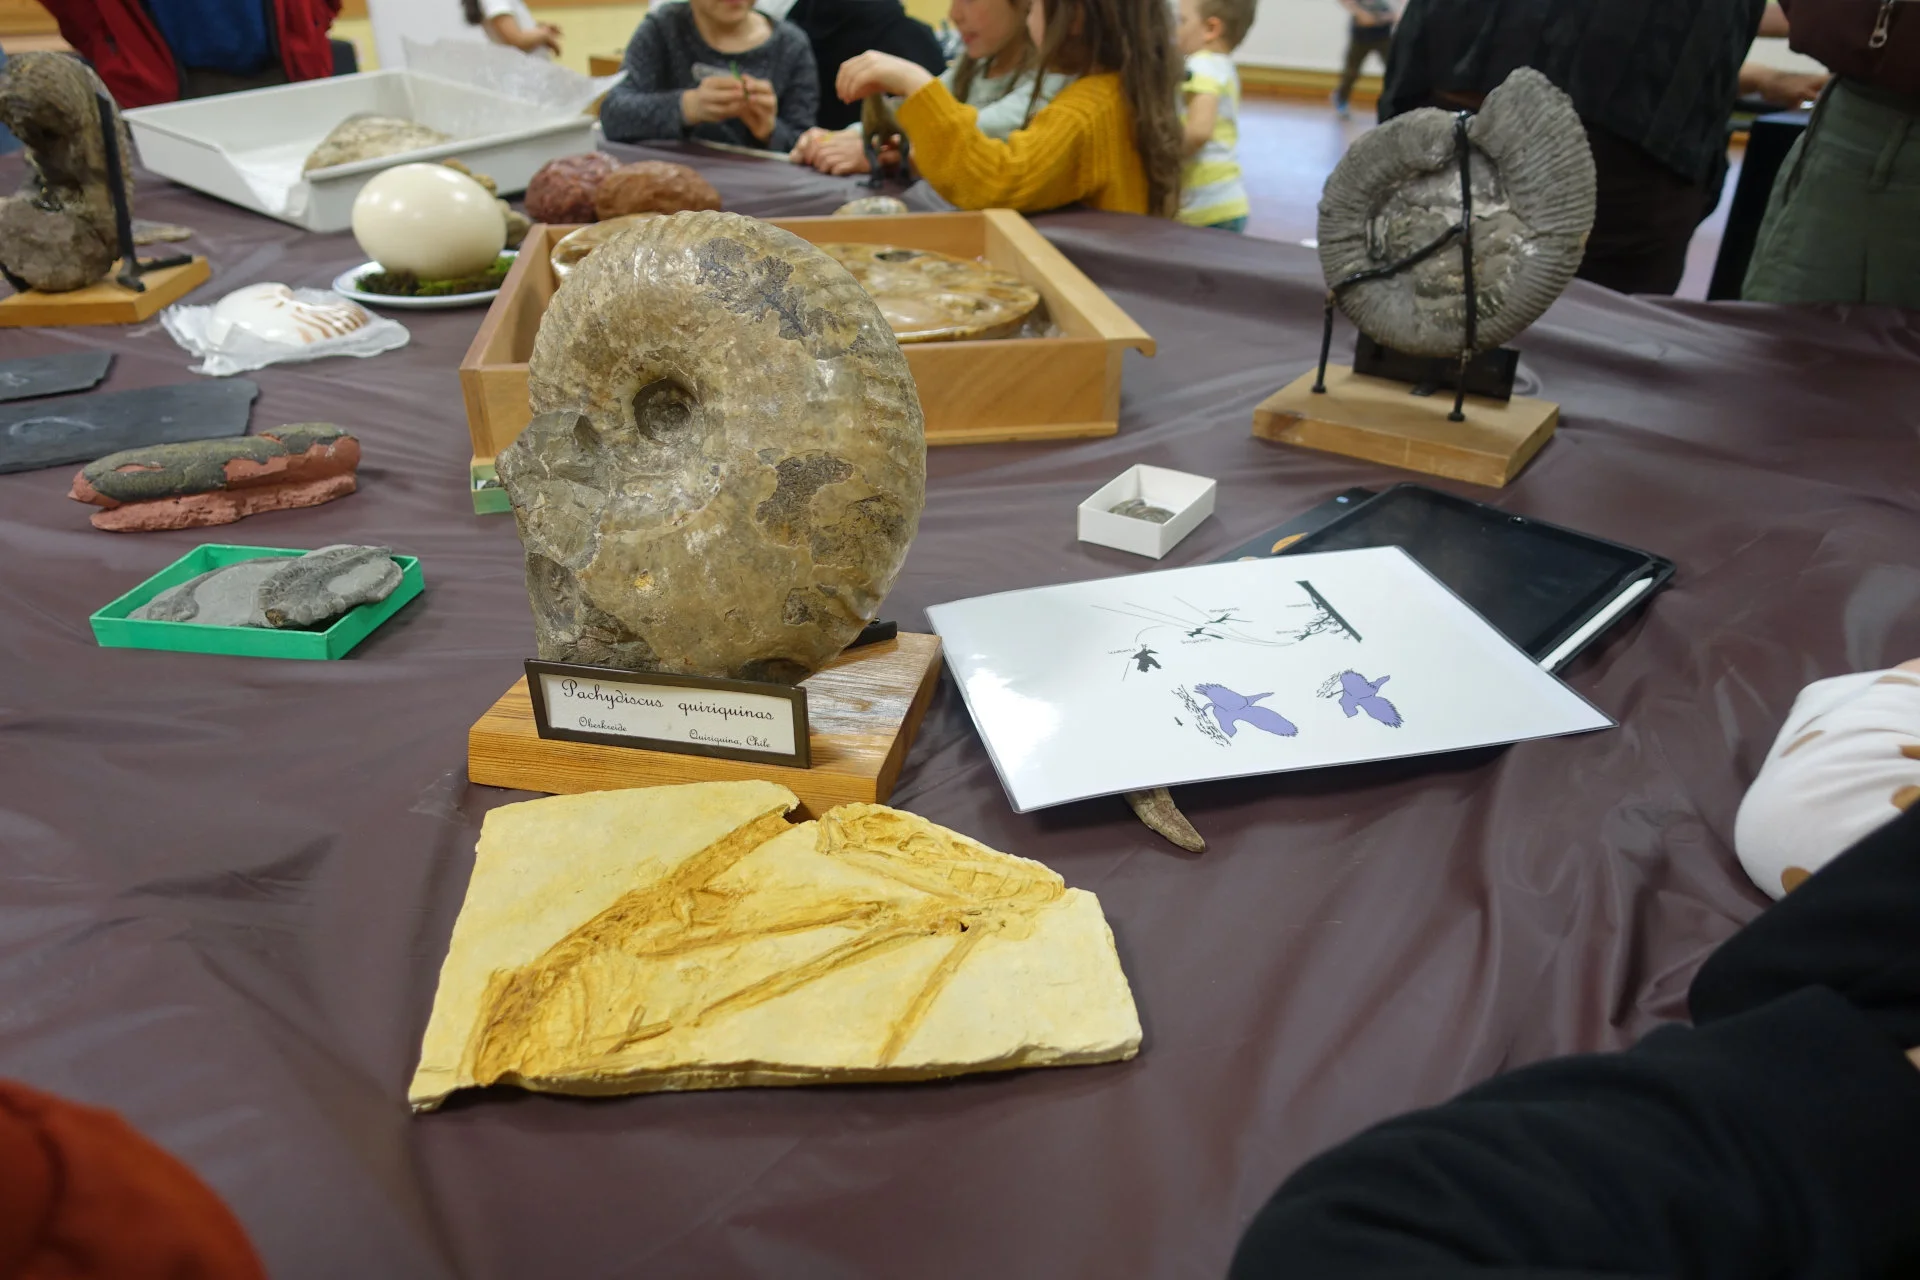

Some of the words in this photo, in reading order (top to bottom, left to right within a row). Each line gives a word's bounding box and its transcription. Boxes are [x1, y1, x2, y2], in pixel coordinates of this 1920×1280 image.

[561, 678, 664, 710] Pachydiscus
[678, 701, 775, 721] quiriquinas
[578, 716, 628, 732] Oberkreide
[689, 728, 743, 746] Quiriquina,
[746, 735, 772, 748] Chile
